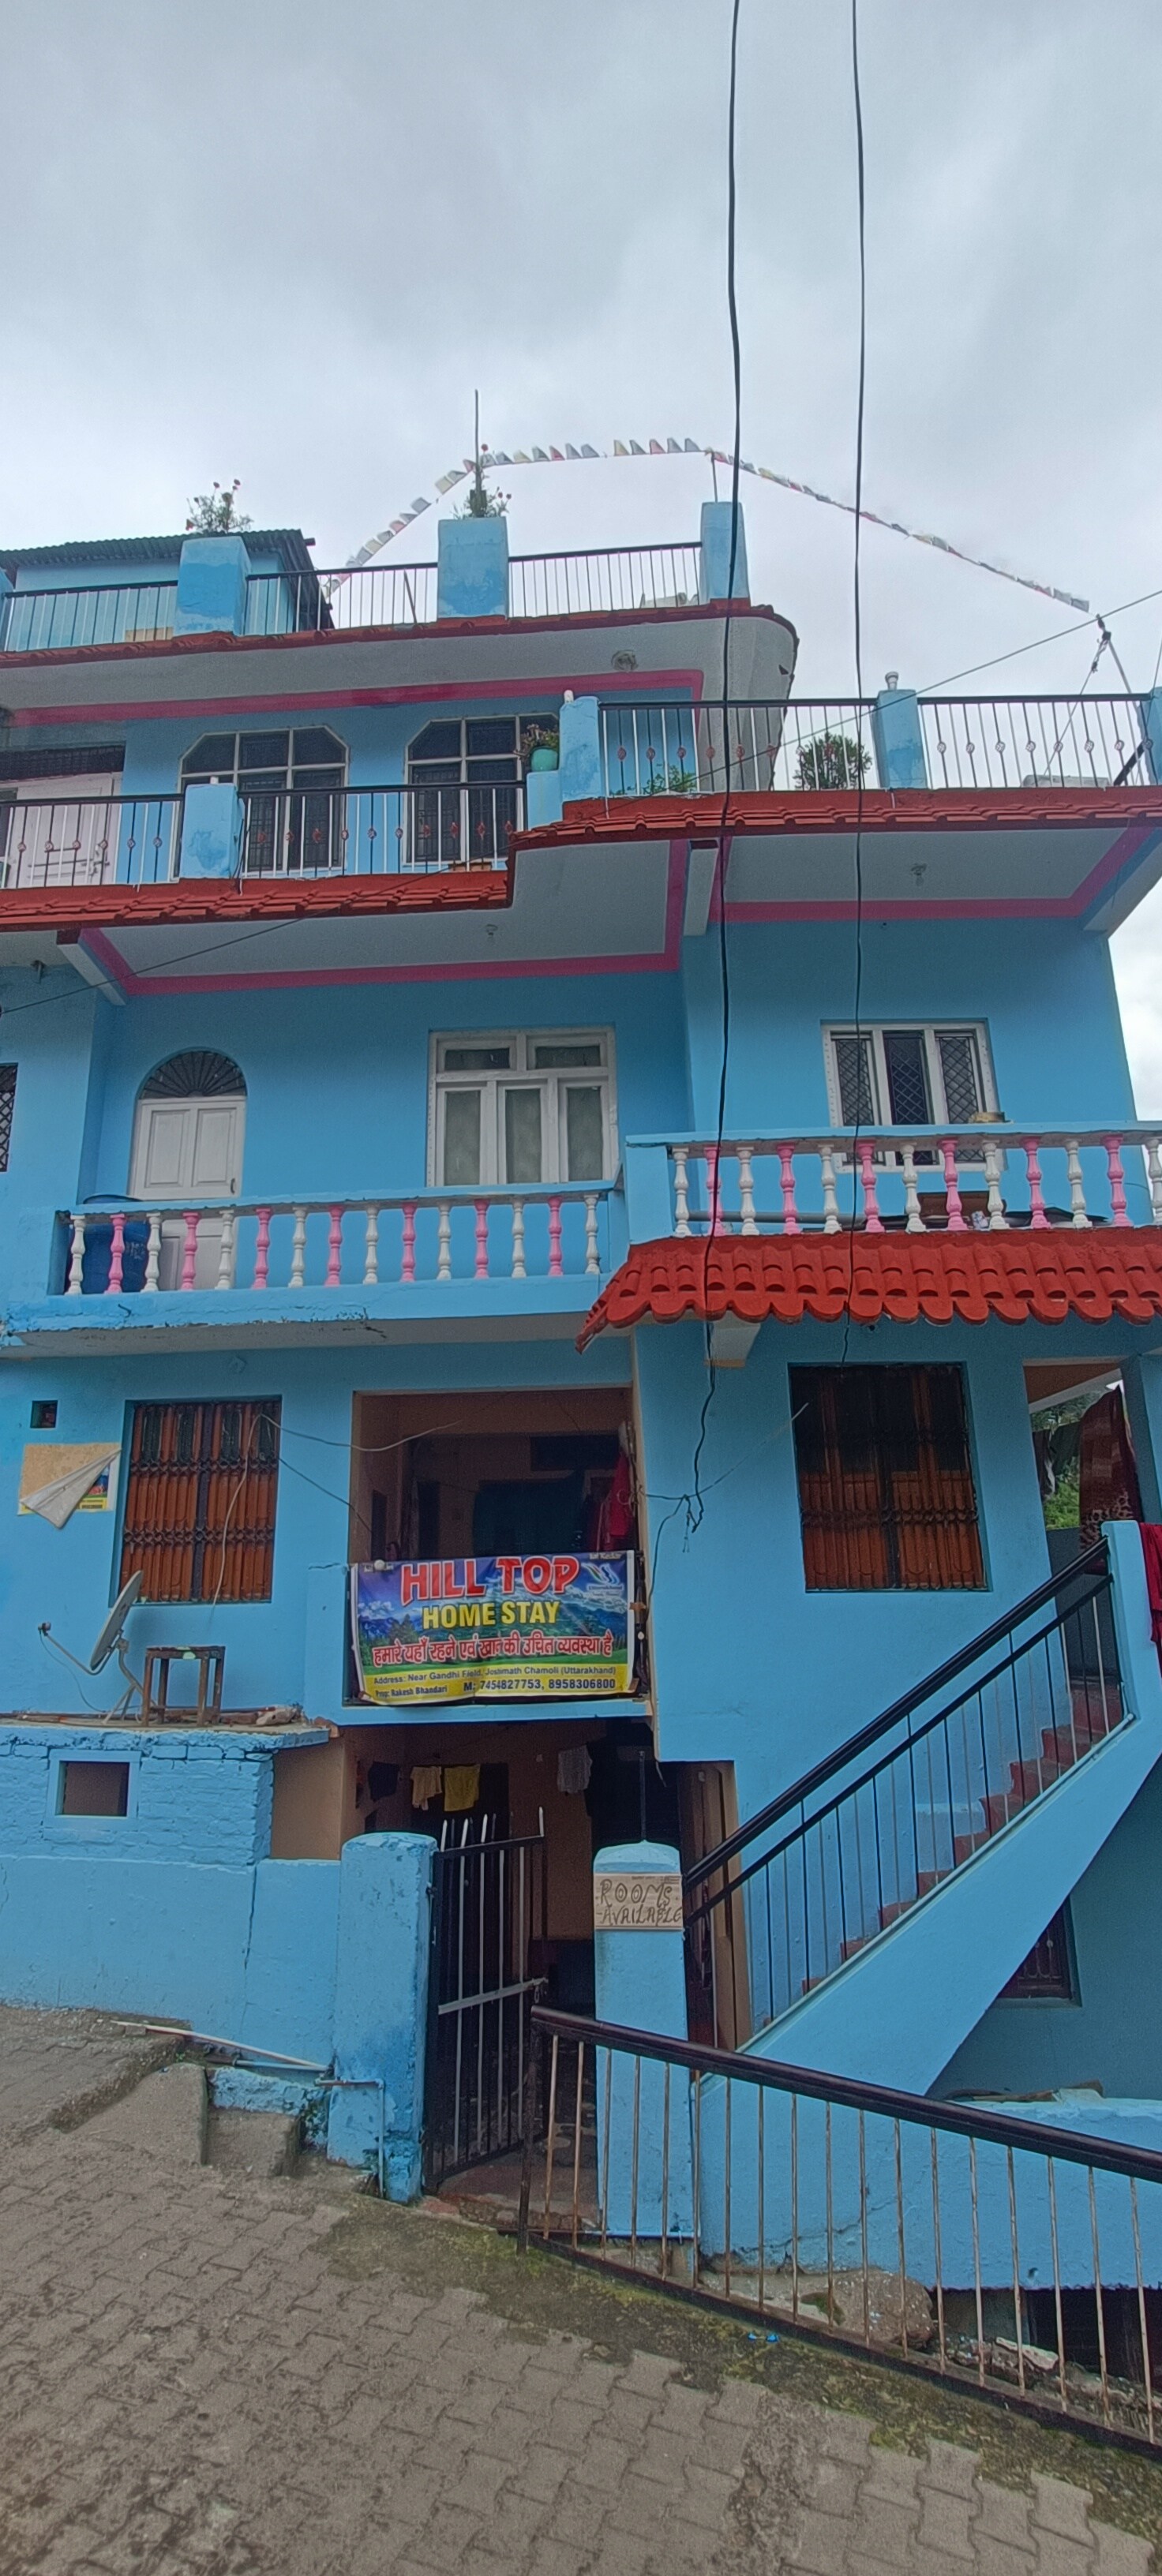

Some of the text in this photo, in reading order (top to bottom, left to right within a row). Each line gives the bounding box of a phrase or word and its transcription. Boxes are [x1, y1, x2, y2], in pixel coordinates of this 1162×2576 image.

[401, 1556, 579, 1606] HILL TOP
[422, 1601, 560, 1630] HOME STAY
[373, 1638, 403, 1667] हमारे
[403, 1637, 429, 1663] यहाँ
[429, 1634, 457, 1662] रहने
[459, 1633, 478, 1659] एवं
[503, 1629, 521, 1655] की
[522, 1629, 556, 1656] उचित
[557, 1636, 601, 1655] व्यवस्था
[602, 1628, 613, 1657] है
[429, 1671, 459, 1679] Gandhi
[561, 1666, 616, 1676] (Uttarakhand)
[463, 1682, 476, 1691] M:
[549, 1679, 616, 1689] 8958306800
[391, 1687, 414, 1696] Rakesh
[415, 1684, 448, 1694] Bhandari
[600, 1879, 673, 1908] ROOMS
